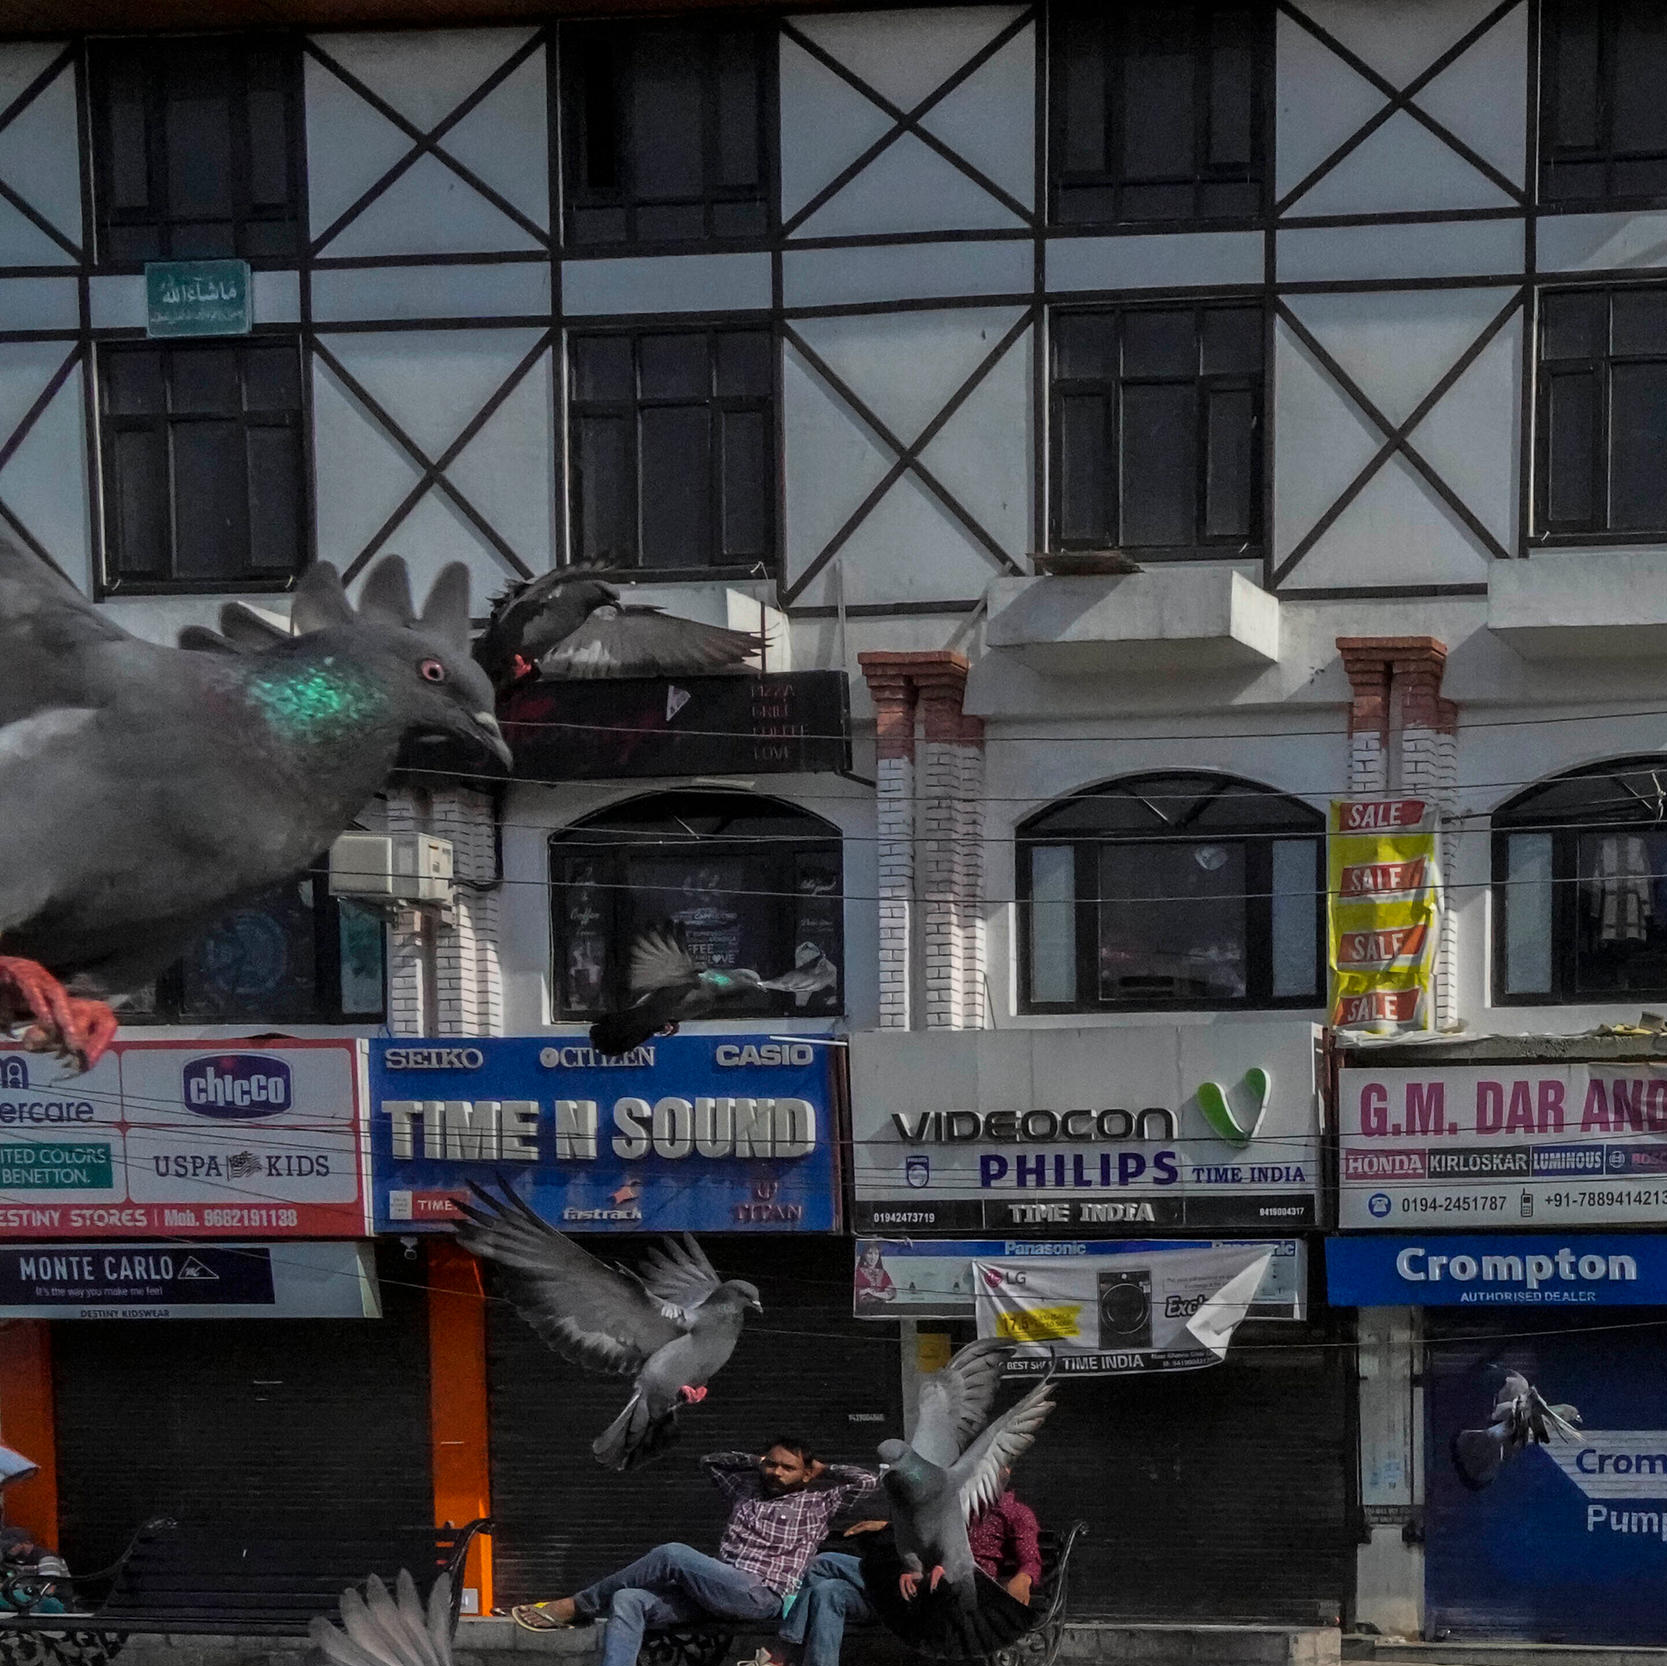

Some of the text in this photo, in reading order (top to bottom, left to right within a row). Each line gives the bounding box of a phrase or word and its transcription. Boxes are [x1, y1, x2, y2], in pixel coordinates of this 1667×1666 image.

[1348, 803, 1403, 827] SALE
[1352, 867, 1402, 891] SALE
[1354, 933, 1404, 960] SALE
[1347, 996, 1399, 1021] SALE
[385, 1048, 484, 1069] SEIKO
[560, 1046, 656, 1068] CITIZEN
[715, 1045, 813, 1066] CASIO
[190, 1067, 285, 1106] chicco
[0, 1102, 94, 1123] ercare
[1360, 1082, 1459, 1138] G.M.
[1475, 1080, 1565, 1135] DAR
[381, 1096, 818, 1161] TIME N SOUND
[891, 1107, 1178, 1141] VIDEOCON
[1, 1148, 107, 1164] ITED COLORS
[155, 1154, 330, 1178] USPA KIDS
[1347, 1155, 1423, 1175] HONDA
[1429, 1153, 1529, 1174] KIRLOSKAR
[1532, 1150, 1602, 1171] LUMINOUS
[980, 1151, 1177, 1188] PHILIPS
[1192, 1165, 1305, 1185] TIME INDIA
[563, 1206, 643, 1220] fastrack
[735, 1204, 803, 1220] TITAN
[1007, 1202, 1156, 1224] TIME INDIA
[1402, 1195, 1506, 1214] 0194-2451787
[0, 1210, 147, 1227] ESTINY STORES
[165, 1209, 200, 1226] Mob.
[873, 1211, 936, 1224] 01942473719
[1004, 1241, 1087, 1257] Panasonic
[20, 1256, 95, 1282] MONTE
[104, 1255, 174, 1280] CARLO
[1005, 1271, 1027, 1285] LG
[1397, 1247, 1638, 1289] Crompton
[51, 1287, 66, 1298] the
[67, 1288, 84, 1300] way
[85, 1288, 102, 1300] you
[104, 1287, 128, 1298] make
[131, 1288, 146, 1297] me
[1460, 1290, 1596, 1303] AUTHORISED DEALER
[81, 1309, 170, 1318] DESTINY KIDSWEAR
[1007, 1360, 1029, 1371] BEST
[1062, 1355, 1098, 1371] TIME
[1100, 1354, 1144, 1370] INDIA
